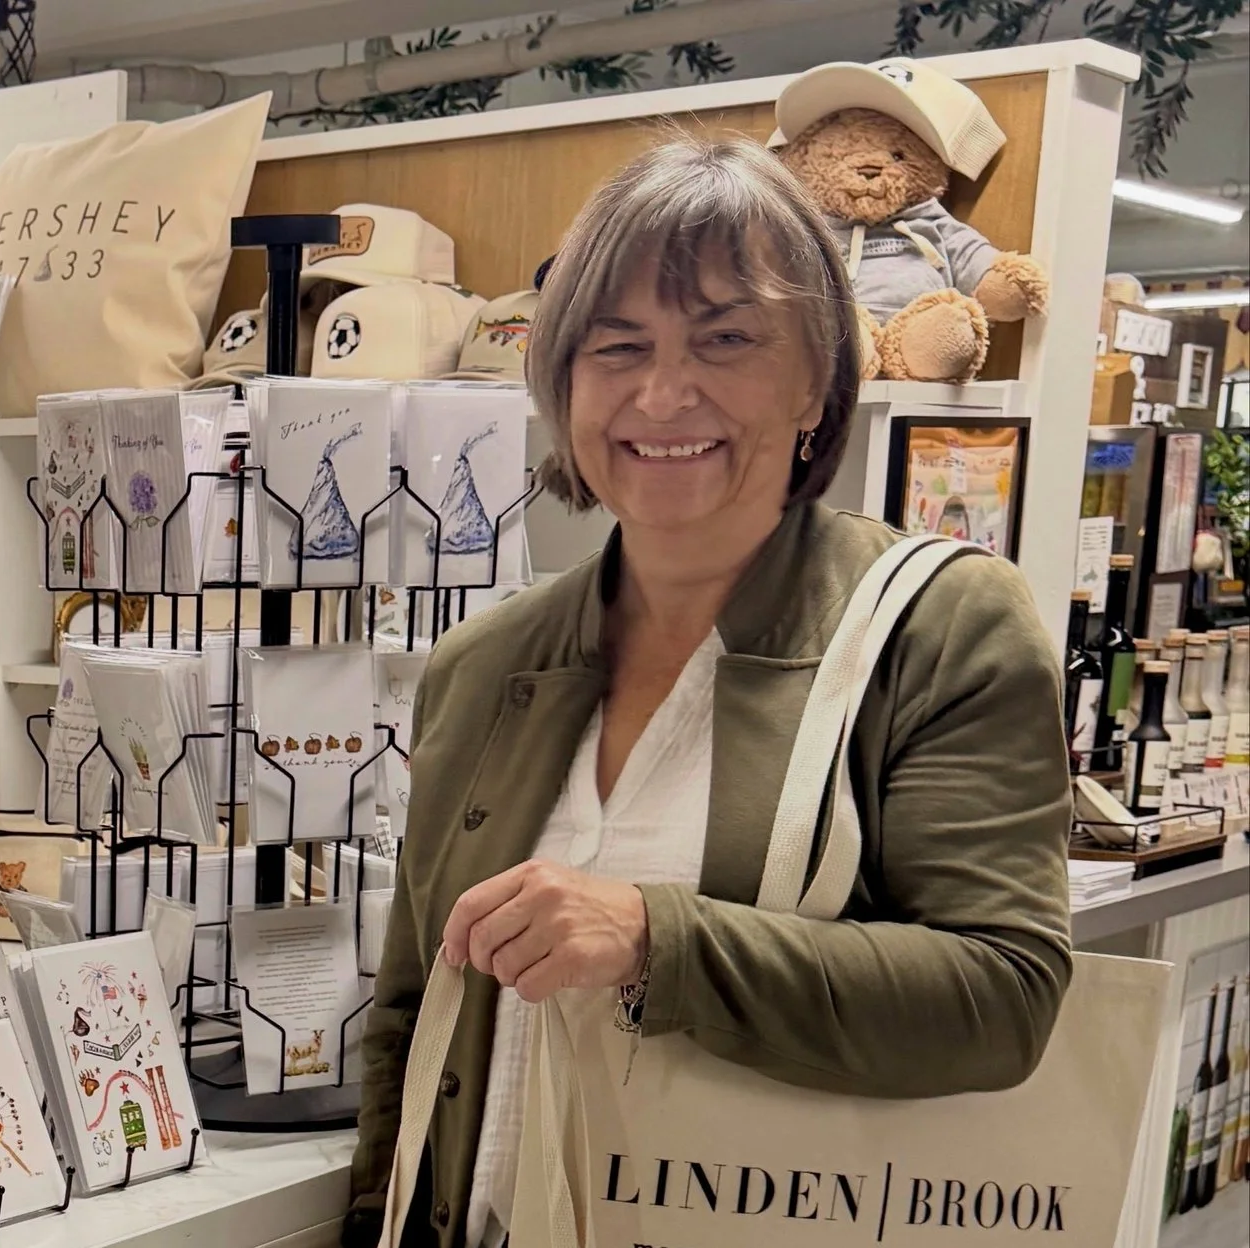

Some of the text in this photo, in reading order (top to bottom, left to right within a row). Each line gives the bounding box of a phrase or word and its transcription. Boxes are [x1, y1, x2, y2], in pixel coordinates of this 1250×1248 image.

[280, 412, 322, 441] Thank
[601, 1152, 1073, 1232] LINDEN BROOK
